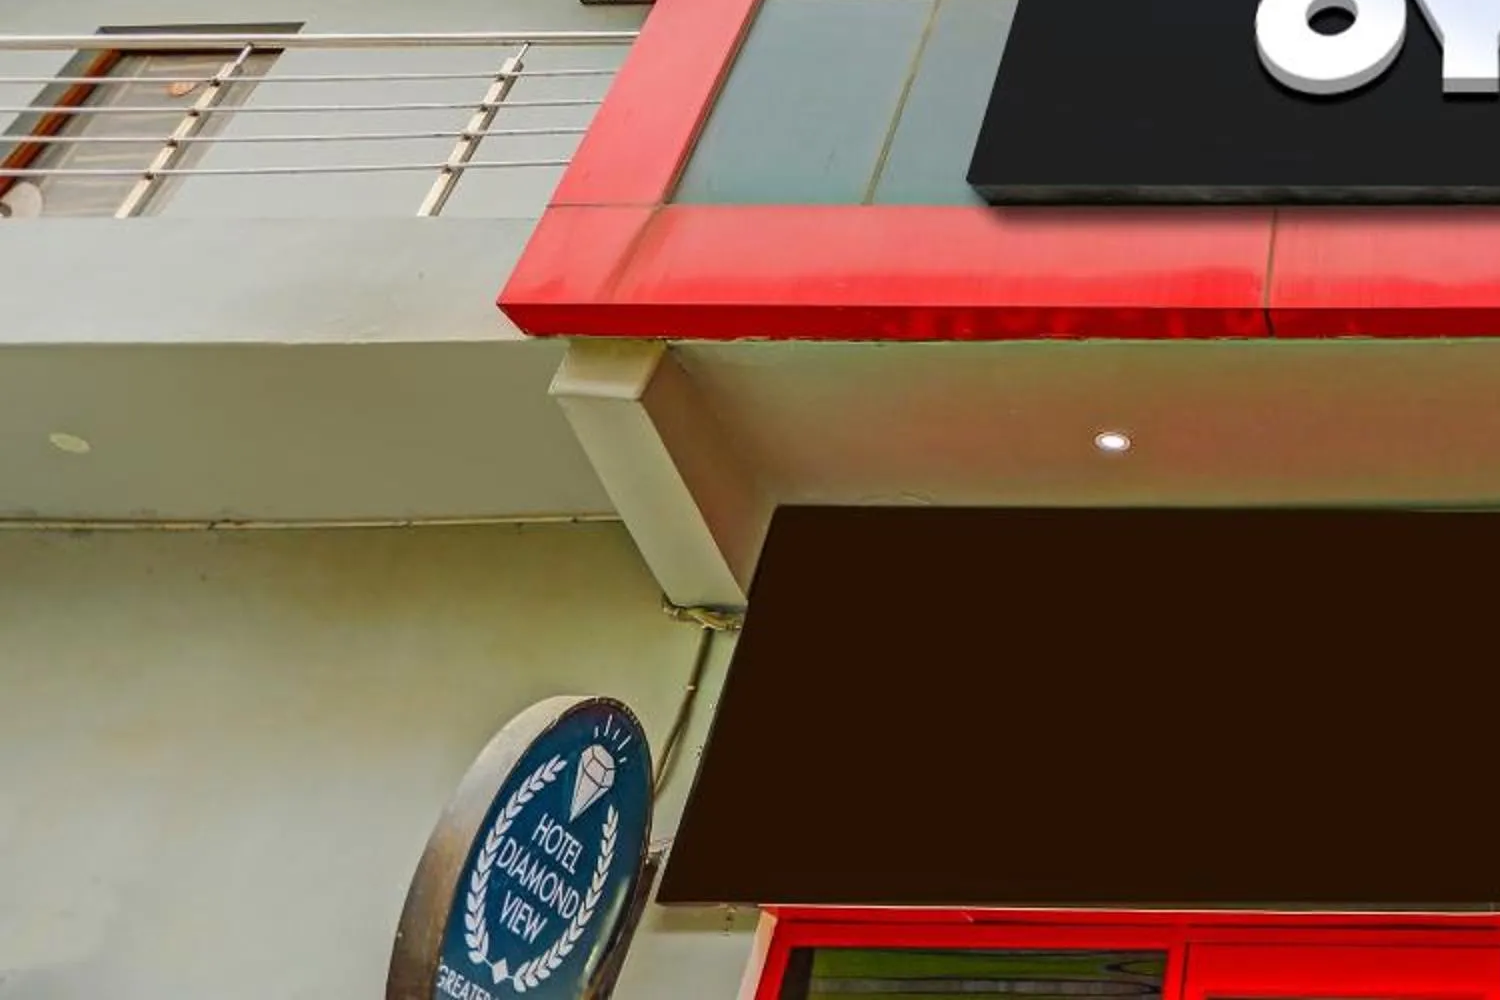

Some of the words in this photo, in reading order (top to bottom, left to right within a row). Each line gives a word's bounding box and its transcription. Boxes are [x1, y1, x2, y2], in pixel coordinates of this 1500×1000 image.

[532, 813, 583, 874] HOTEL
[497, 838, 579, 919] DIAMOND
[499, 890, 548, 944] VIEW
